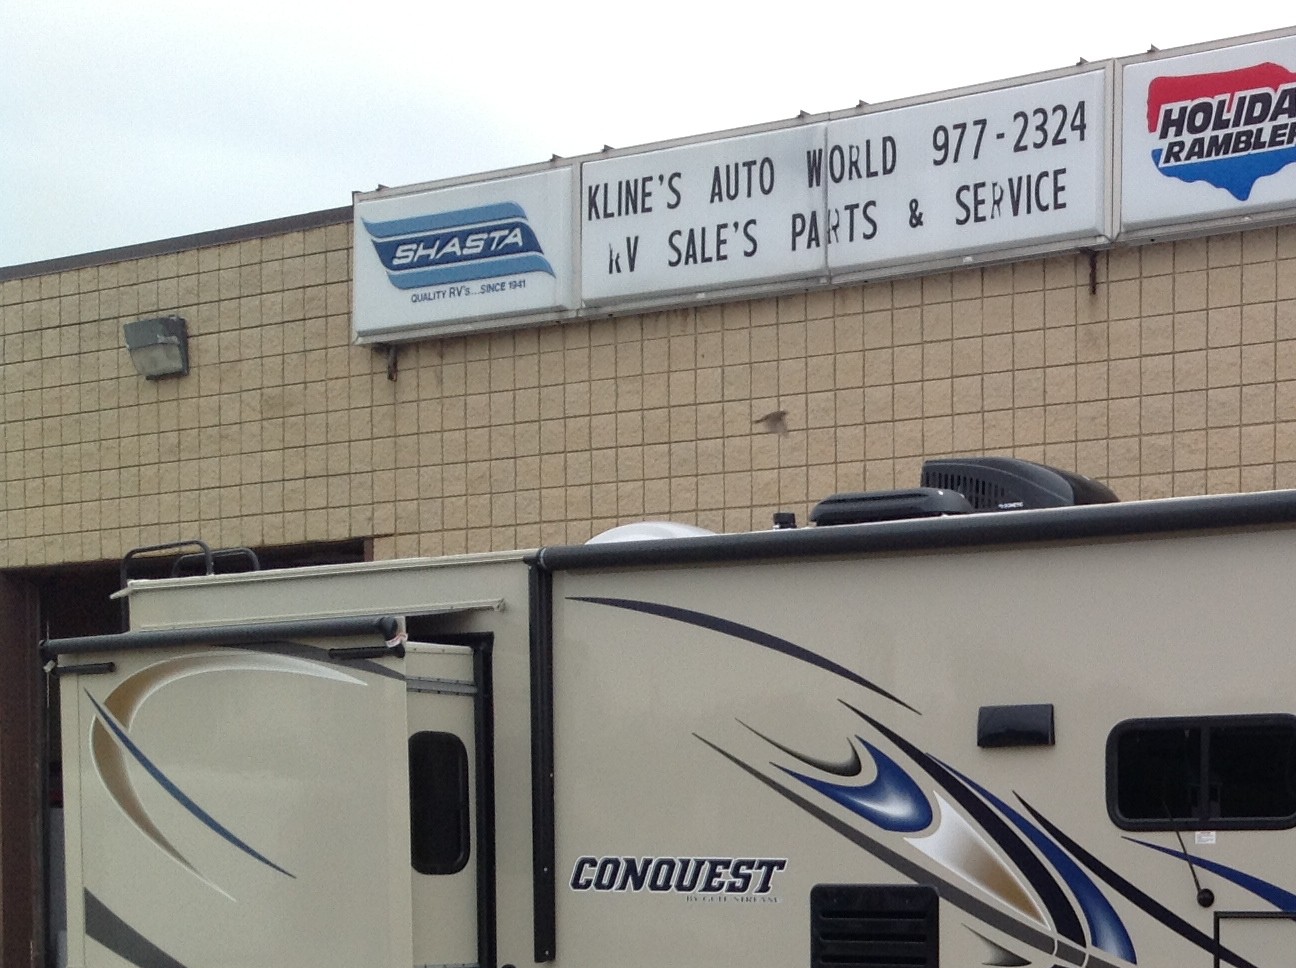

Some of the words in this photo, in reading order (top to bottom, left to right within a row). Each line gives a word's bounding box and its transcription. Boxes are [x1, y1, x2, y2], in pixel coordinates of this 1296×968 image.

[588, 171, 682, 222] KLINE'S
[709, 156, 775, 204] AUTO
[806, 135, 897, 189] WORLD
[668, 218, 759, 267] SALE'S
[791, 200, 878, 252] PARTS
[908, 198, 924, 229] &
[955, 168, 1068, 226] SERVICE
[391, 227, 524, 265] SHASTA
[410, 290, 447, 303] QUALITY
[570, 856, 787, 894] CONQUEST
